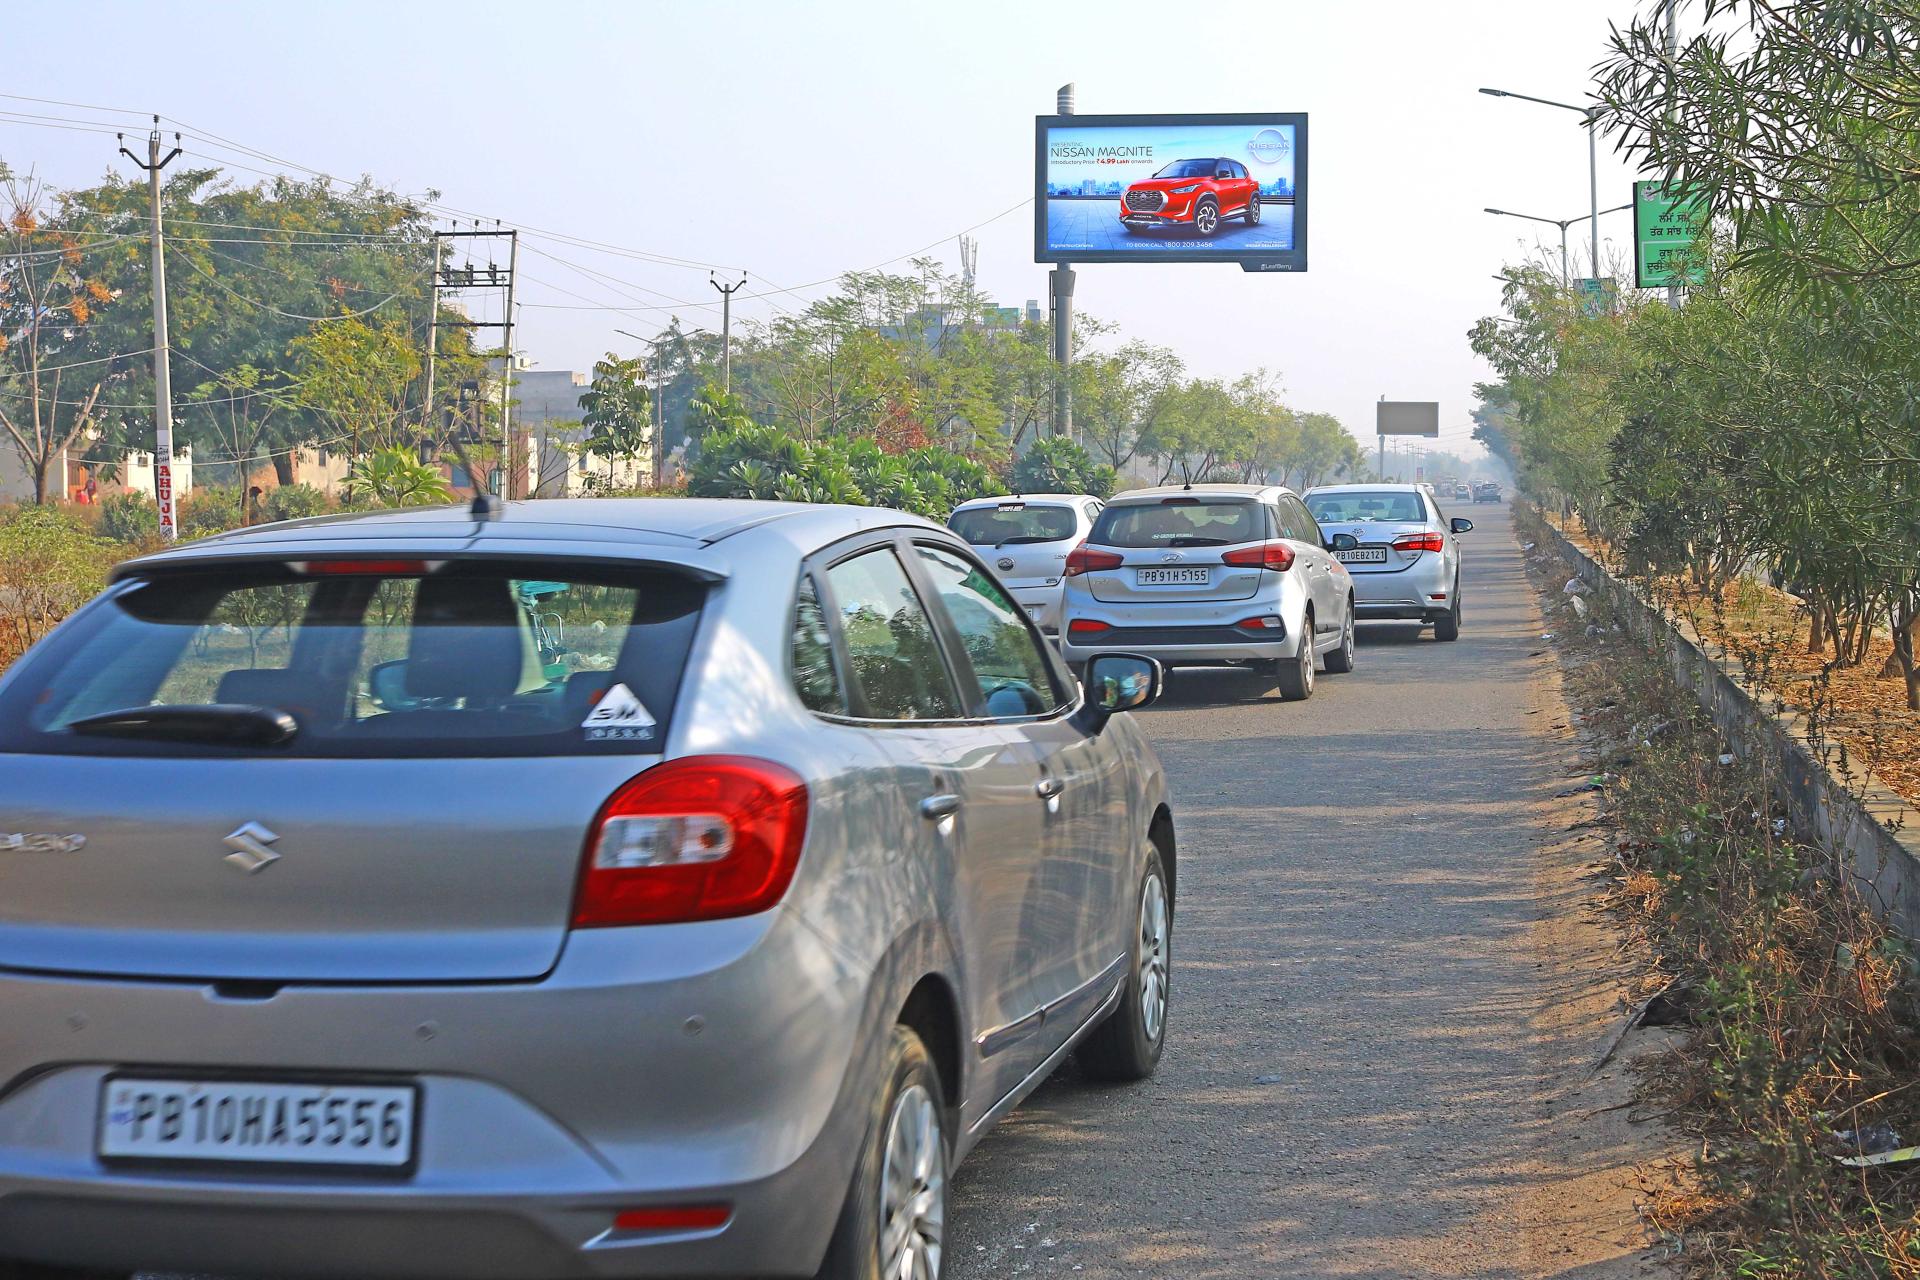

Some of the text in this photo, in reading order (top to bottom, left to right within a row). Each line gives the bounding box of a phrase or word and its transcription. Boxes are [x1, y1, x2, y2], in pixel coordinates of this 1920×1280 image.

[1051, 147, 1153, 157] NISSAN MAGNITE
[160, 466, 172, 525] AHUJA
[1336, 551, 1384, 560] PB10EB2121
[131, 1094, 402, 1149] PB10HA5556
